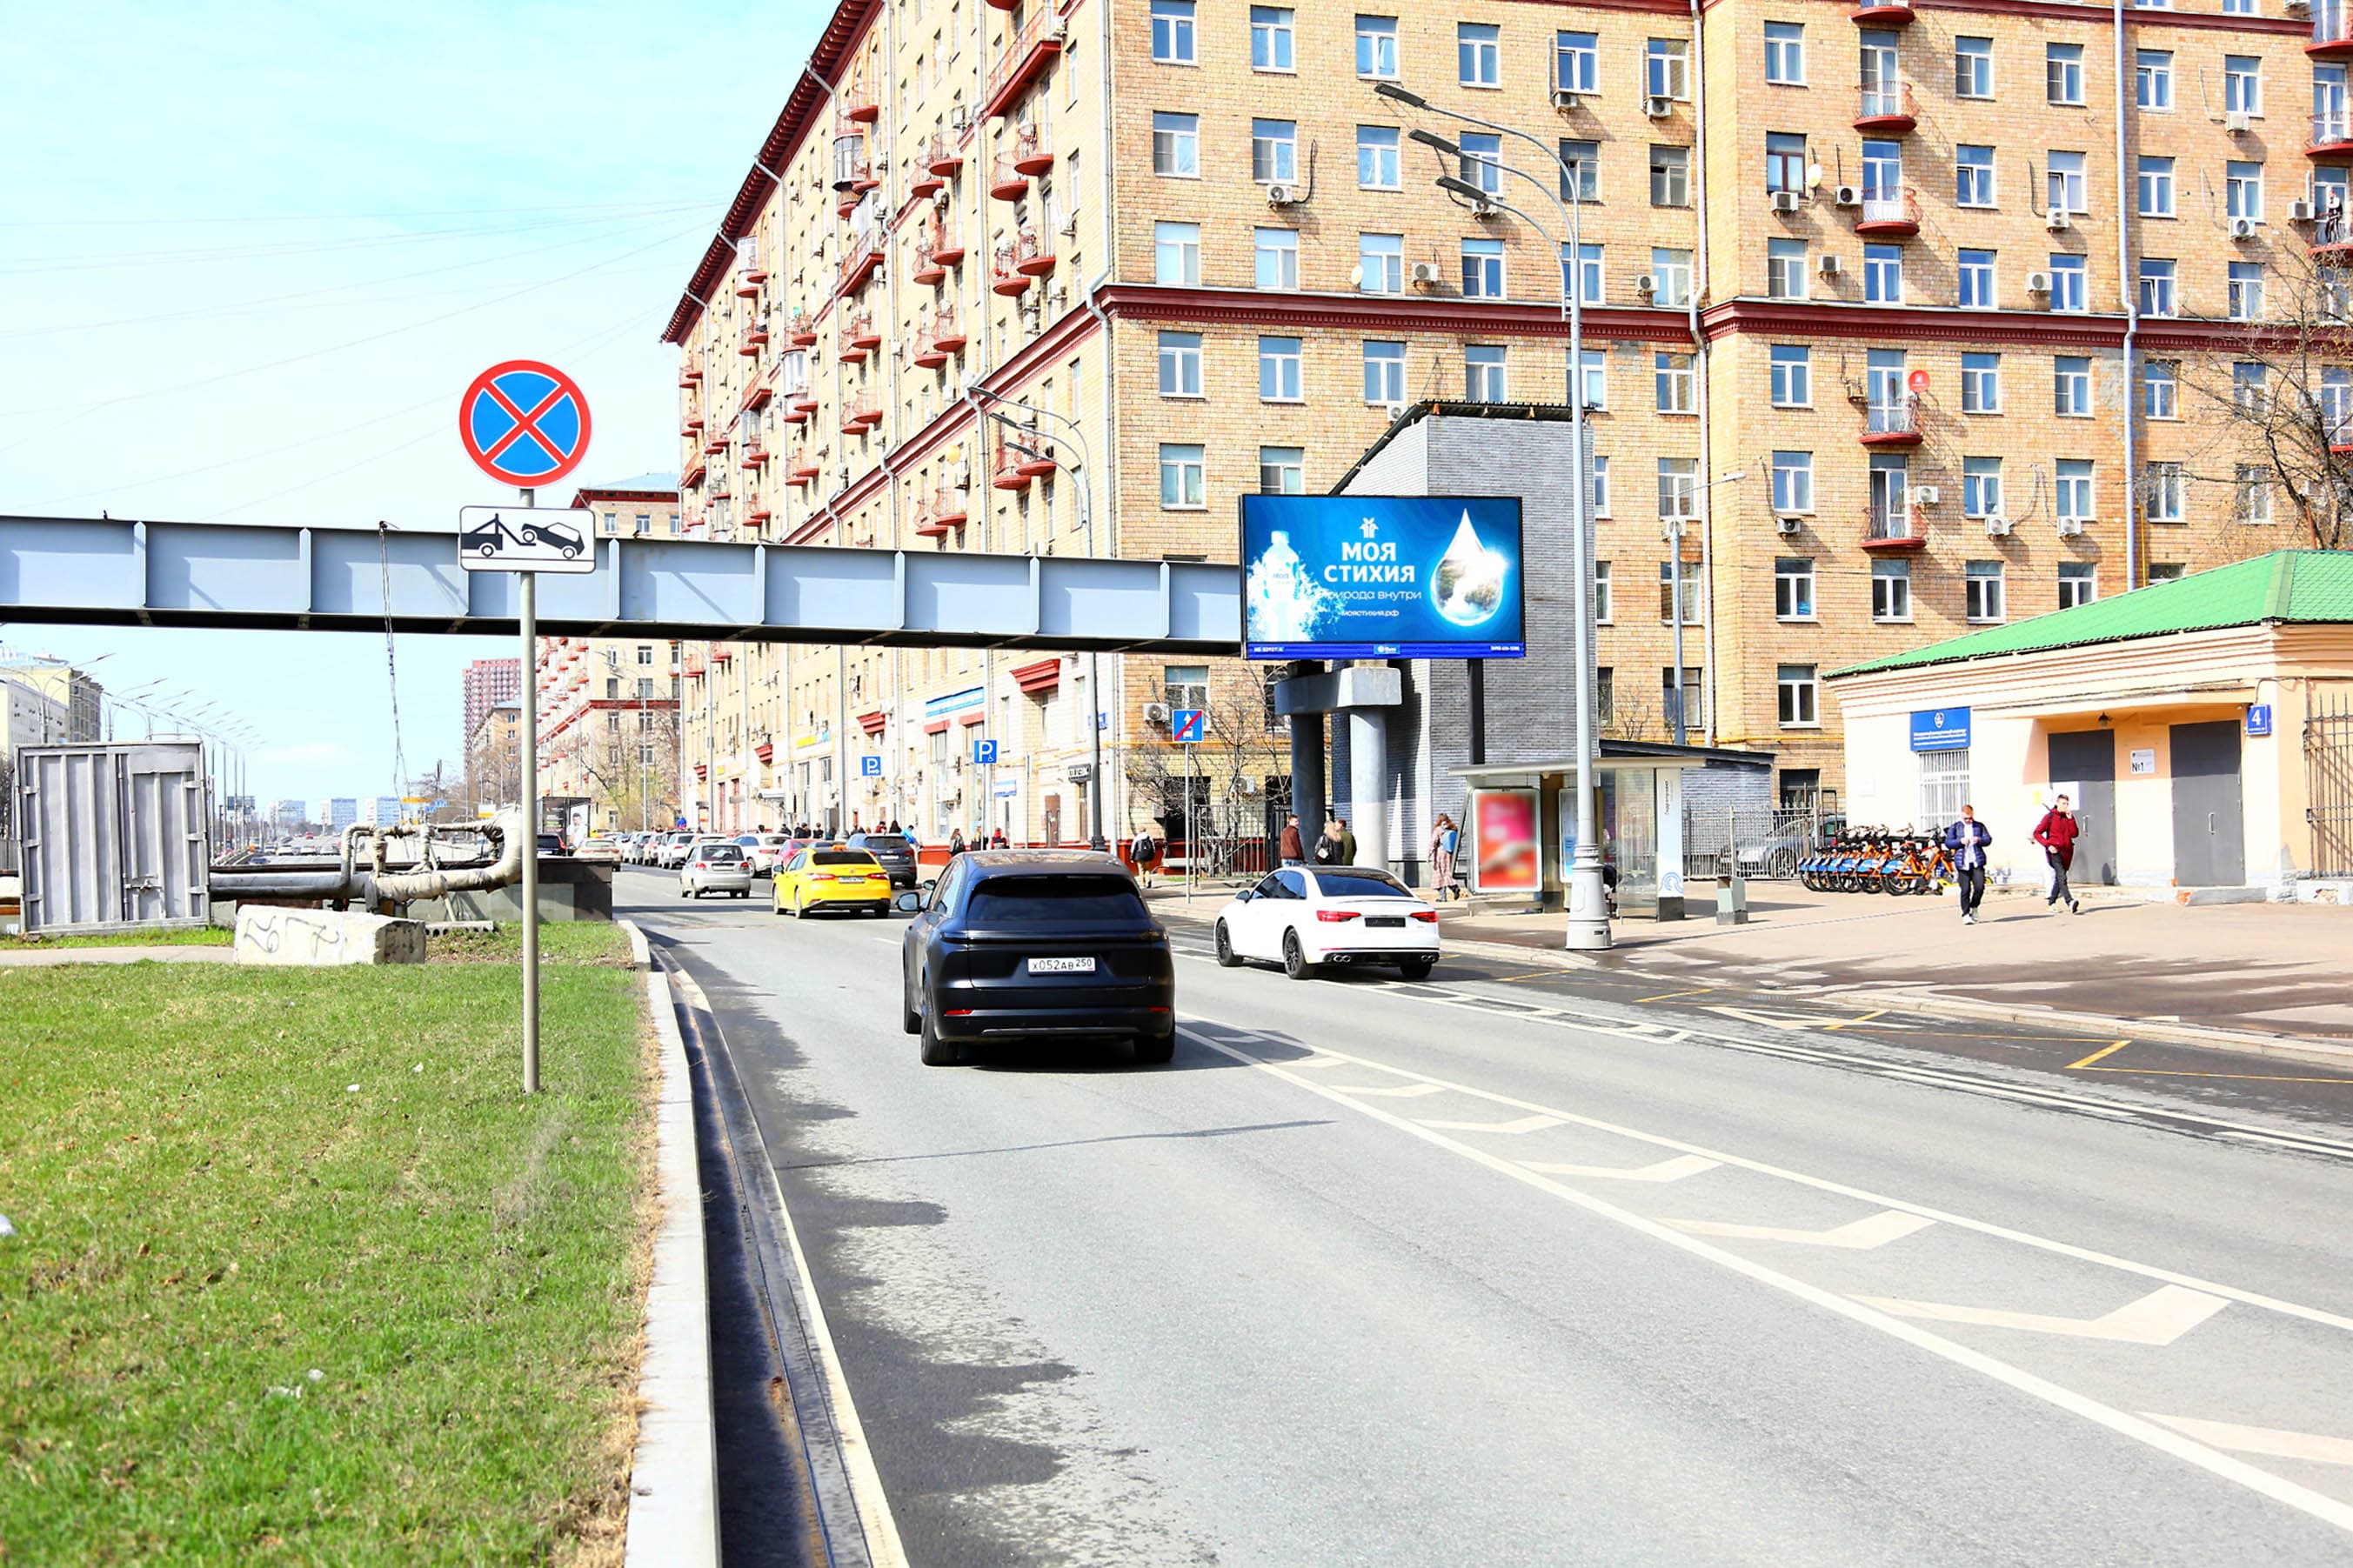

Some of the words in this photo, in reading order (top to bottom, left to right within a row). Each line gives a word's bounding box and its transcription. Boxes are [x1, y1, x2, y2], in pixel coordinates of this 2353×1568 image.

[1341, 542, 1396, 562] МОЯ
[1324, 565, 1415, 583] СТИХИЯ
[1321, 591, 1374, 601] рирода
[1377, 591, 1422, 601] внутри
[2251, 709, 2262, 725] 4
